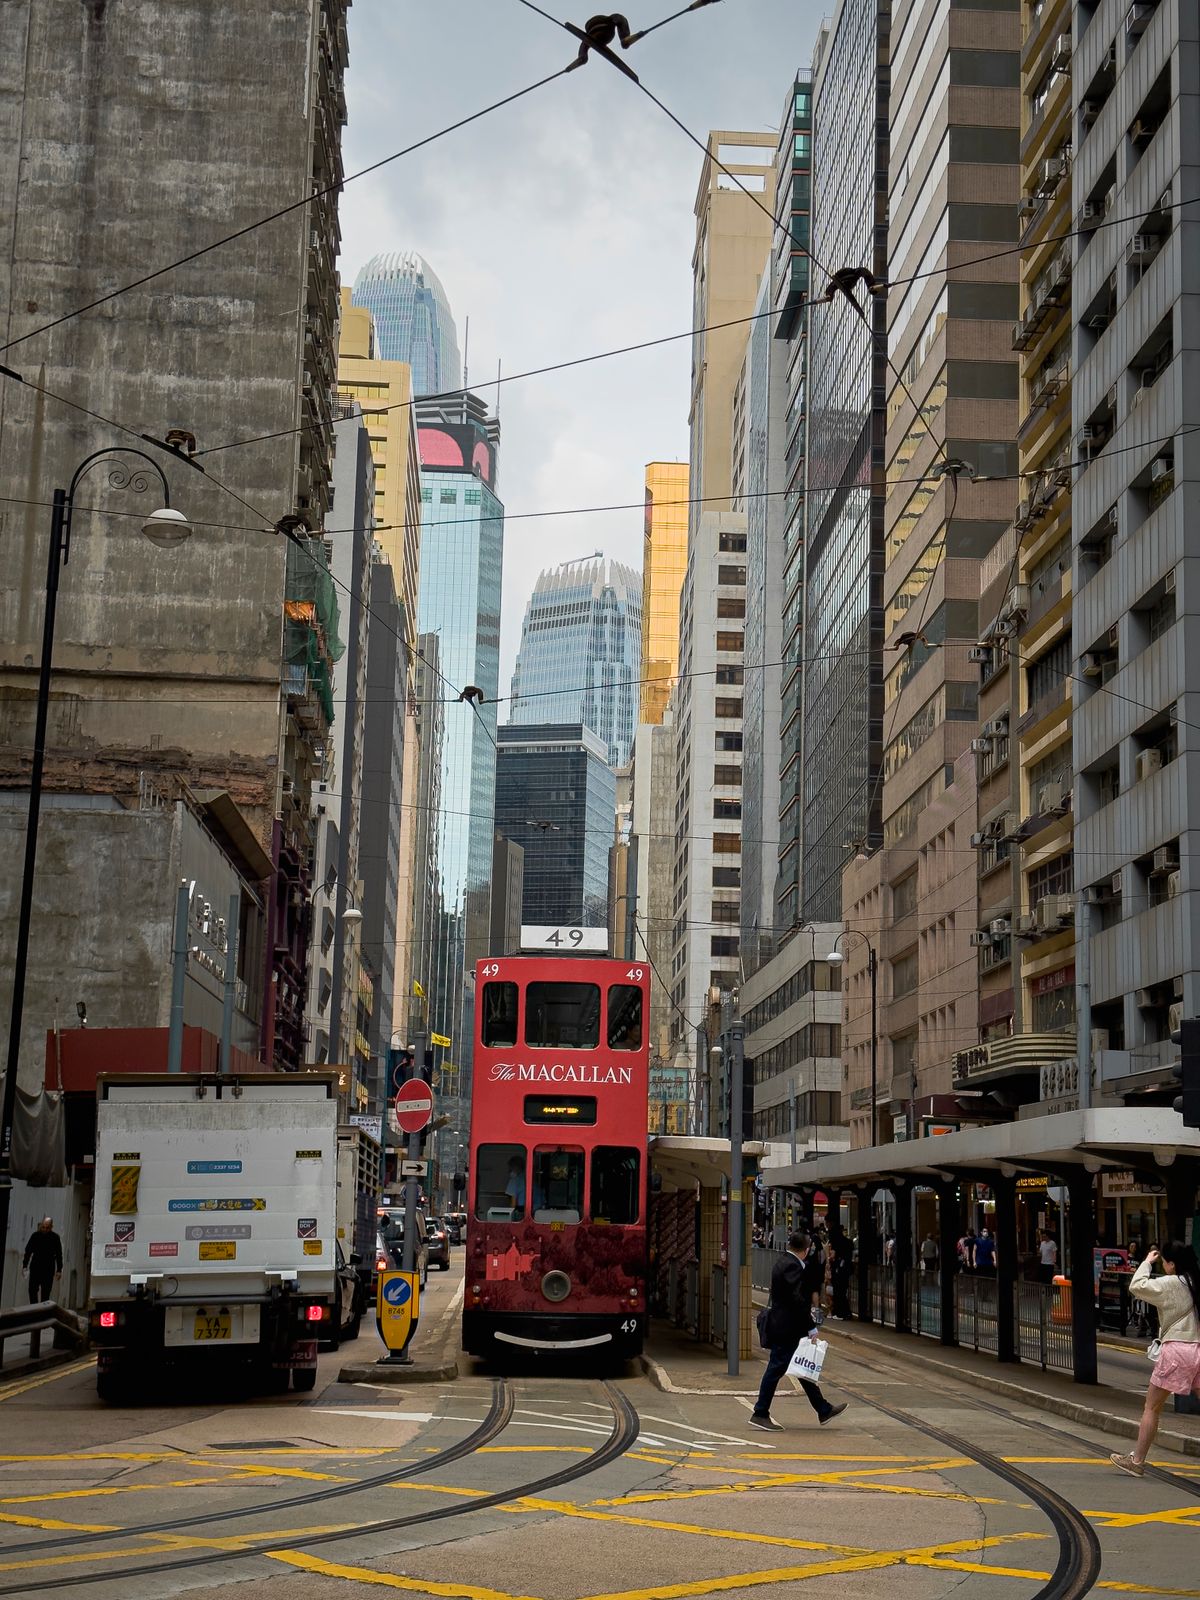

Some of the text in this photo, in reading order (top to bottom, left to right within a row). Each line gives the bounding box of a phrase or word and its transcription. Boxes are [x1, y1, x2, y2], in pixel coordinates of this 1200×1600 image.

[545, 929, 584, 947] 49
[482, 963, 499, 977] 49
[625, 968, 643, 982] 49
[487, 1063, 633, 1084] The MACALLAN
[205, 1318, 221, 1328] YA
[620, 1319, 638, 1333] 49
[197, 1328, 228, 1339] 7377
[794, 1356, 816, 1371] ultra
